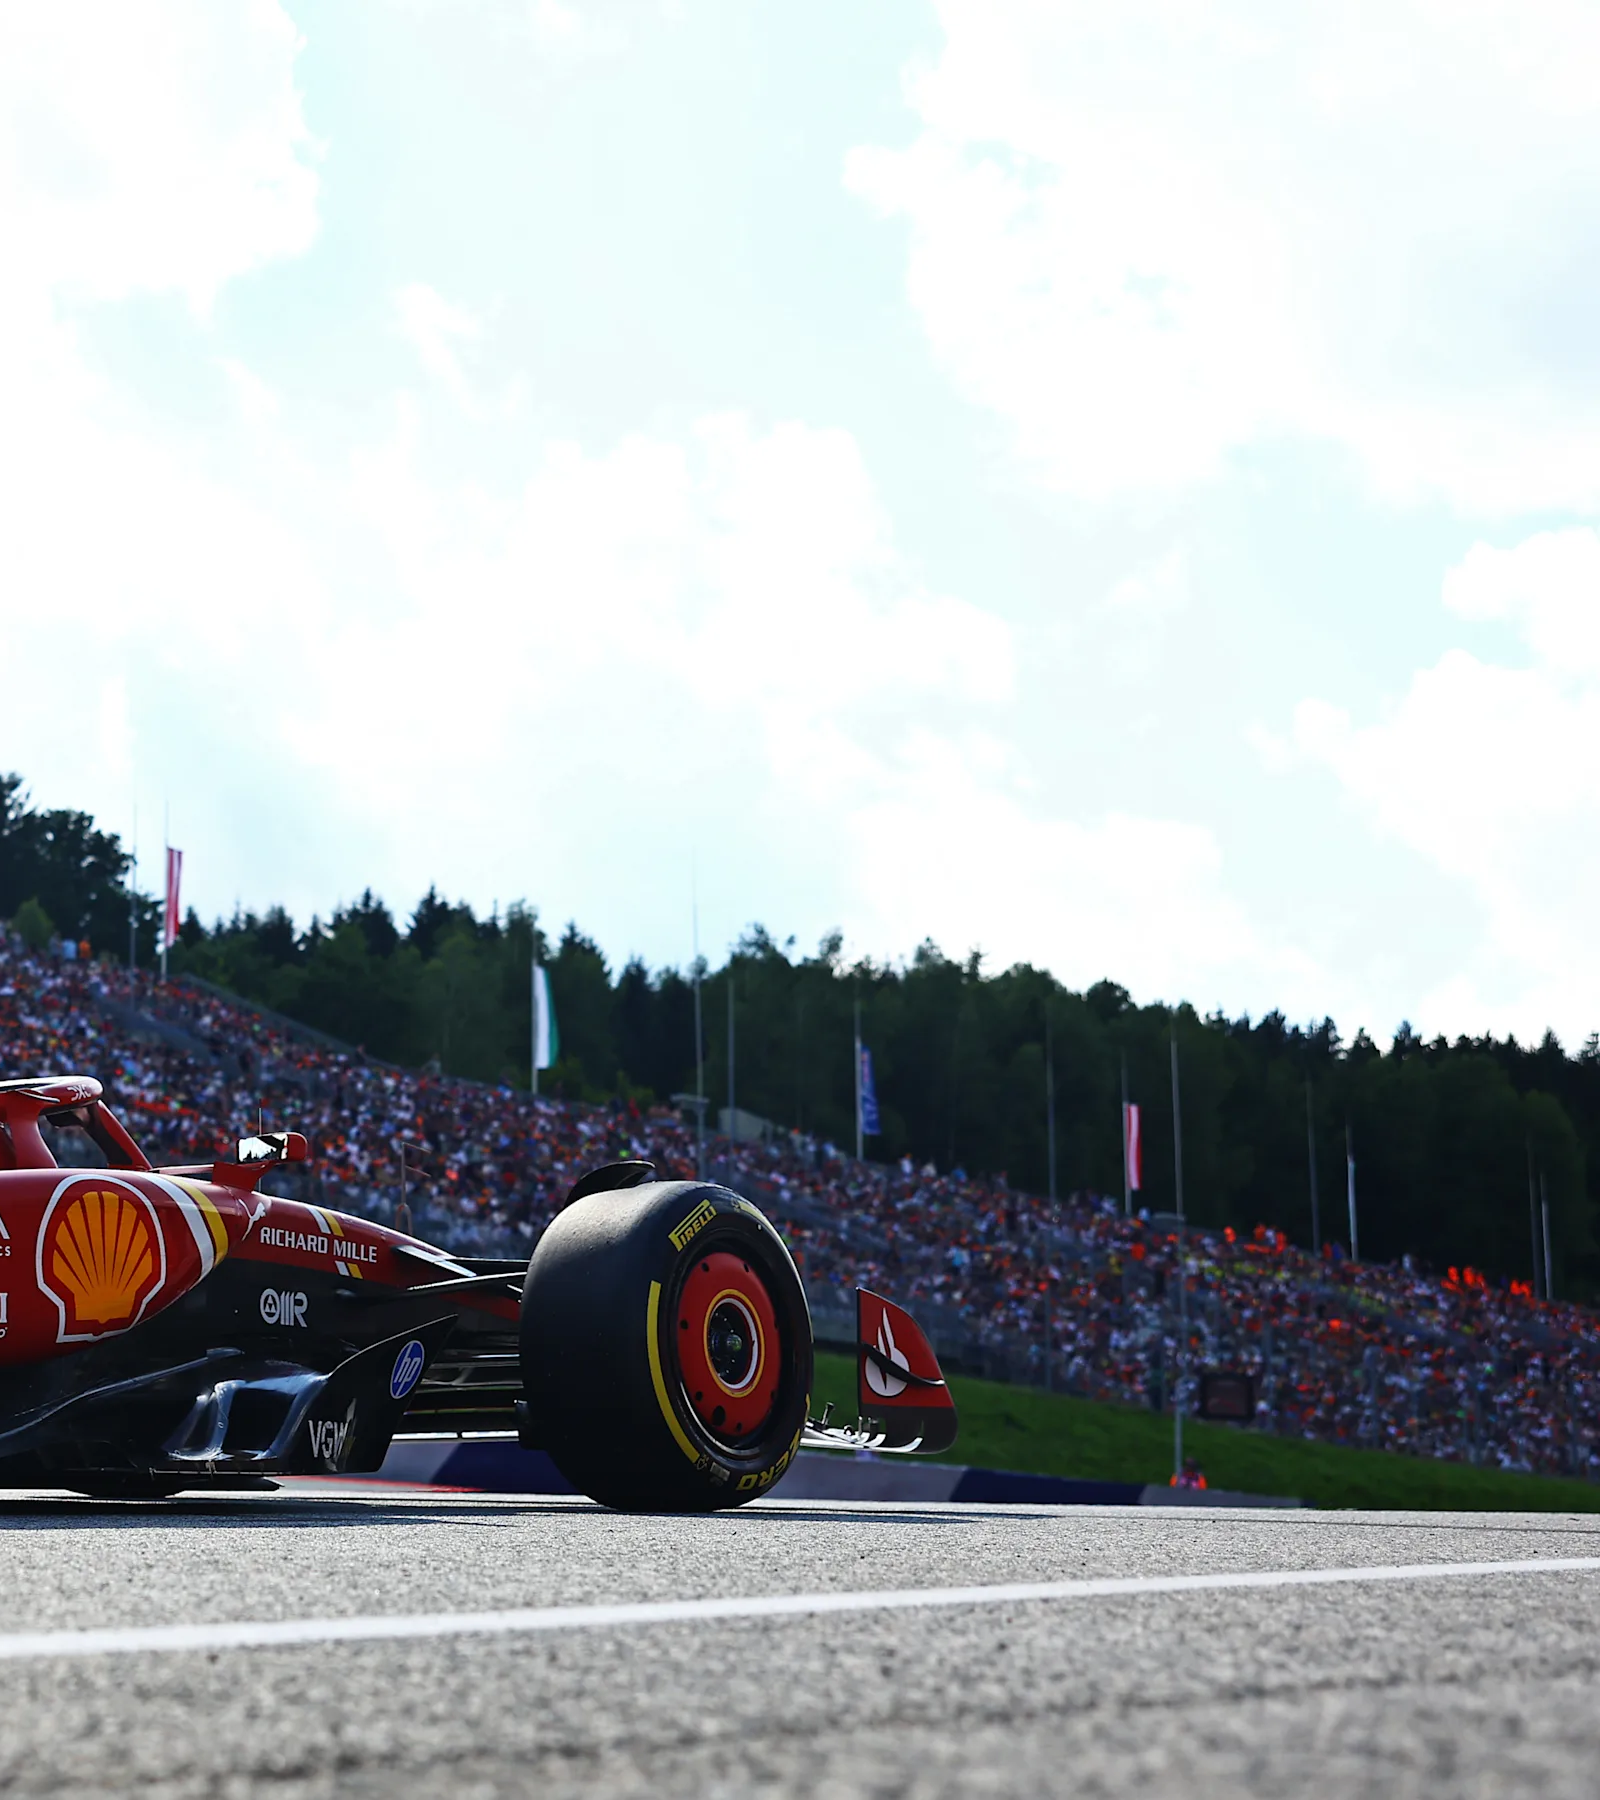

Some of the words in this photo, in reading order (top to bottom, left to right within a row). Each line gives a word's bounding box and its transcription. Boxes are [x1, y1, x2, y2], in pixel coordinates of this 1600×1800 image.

[260, 1226, 328, 1254] RICHARD
[333, 1239, 377, 1263] MILLE
[668, 1199, 718, 1252] PIRELLI
[393, 1341, 422, 1398] hp
